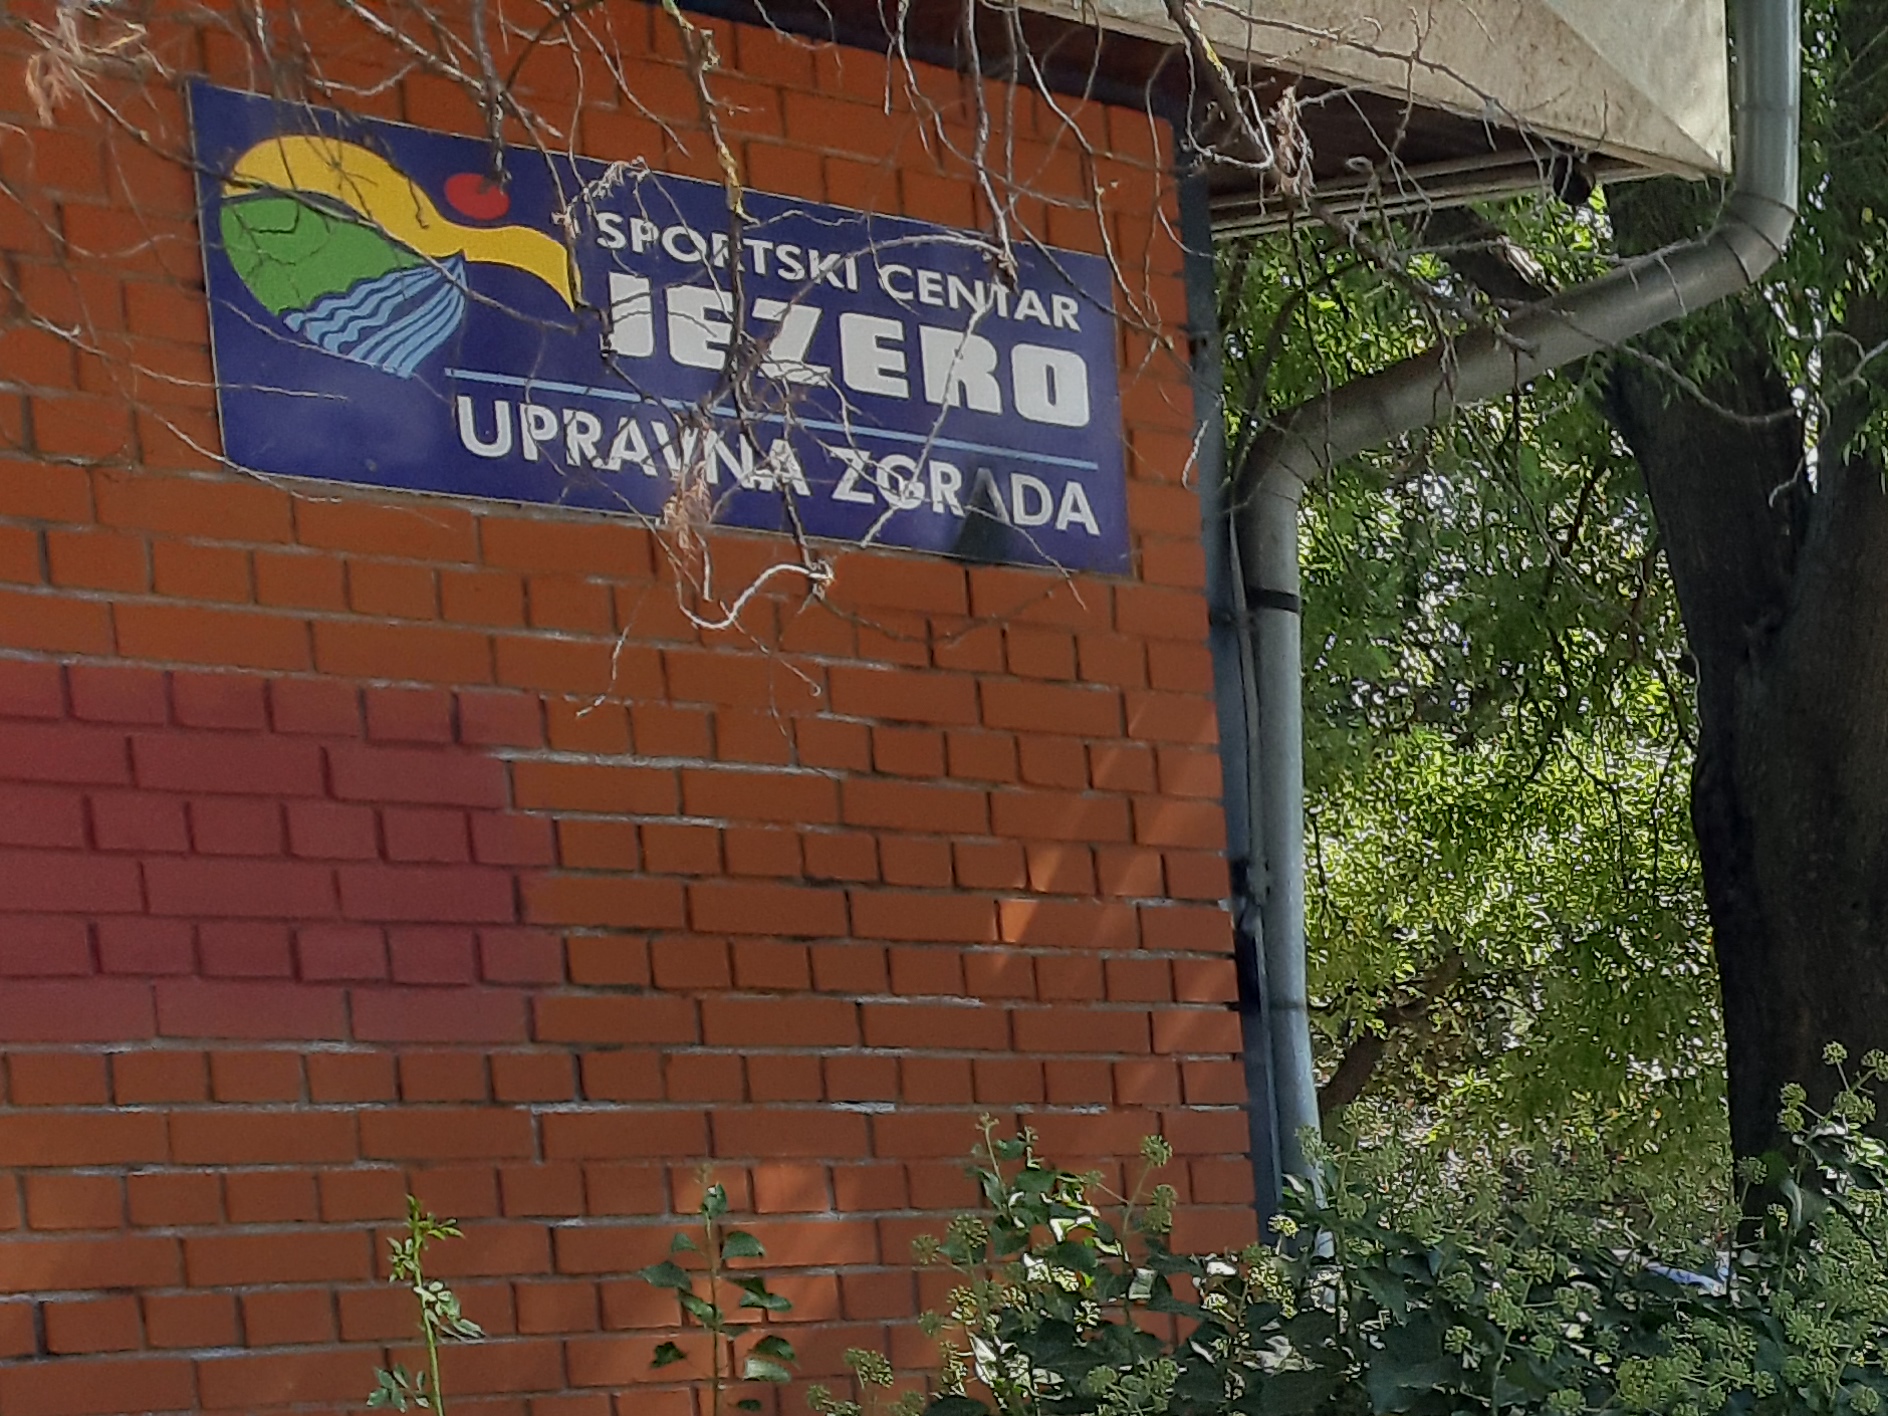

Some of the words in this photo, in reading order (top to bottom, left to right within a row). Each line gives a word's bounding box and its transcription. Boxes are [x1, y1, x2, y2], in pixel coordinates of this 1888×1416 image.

[596, 211, 859, 292] SPORTSKI
[877, 263, 1082, 333] CENTAR
[599, 271, 1091, 428] JEZERO
[456, 394, 812, 497] UPRAVNA
[829, 445, 1101, 537] ZGRADA
